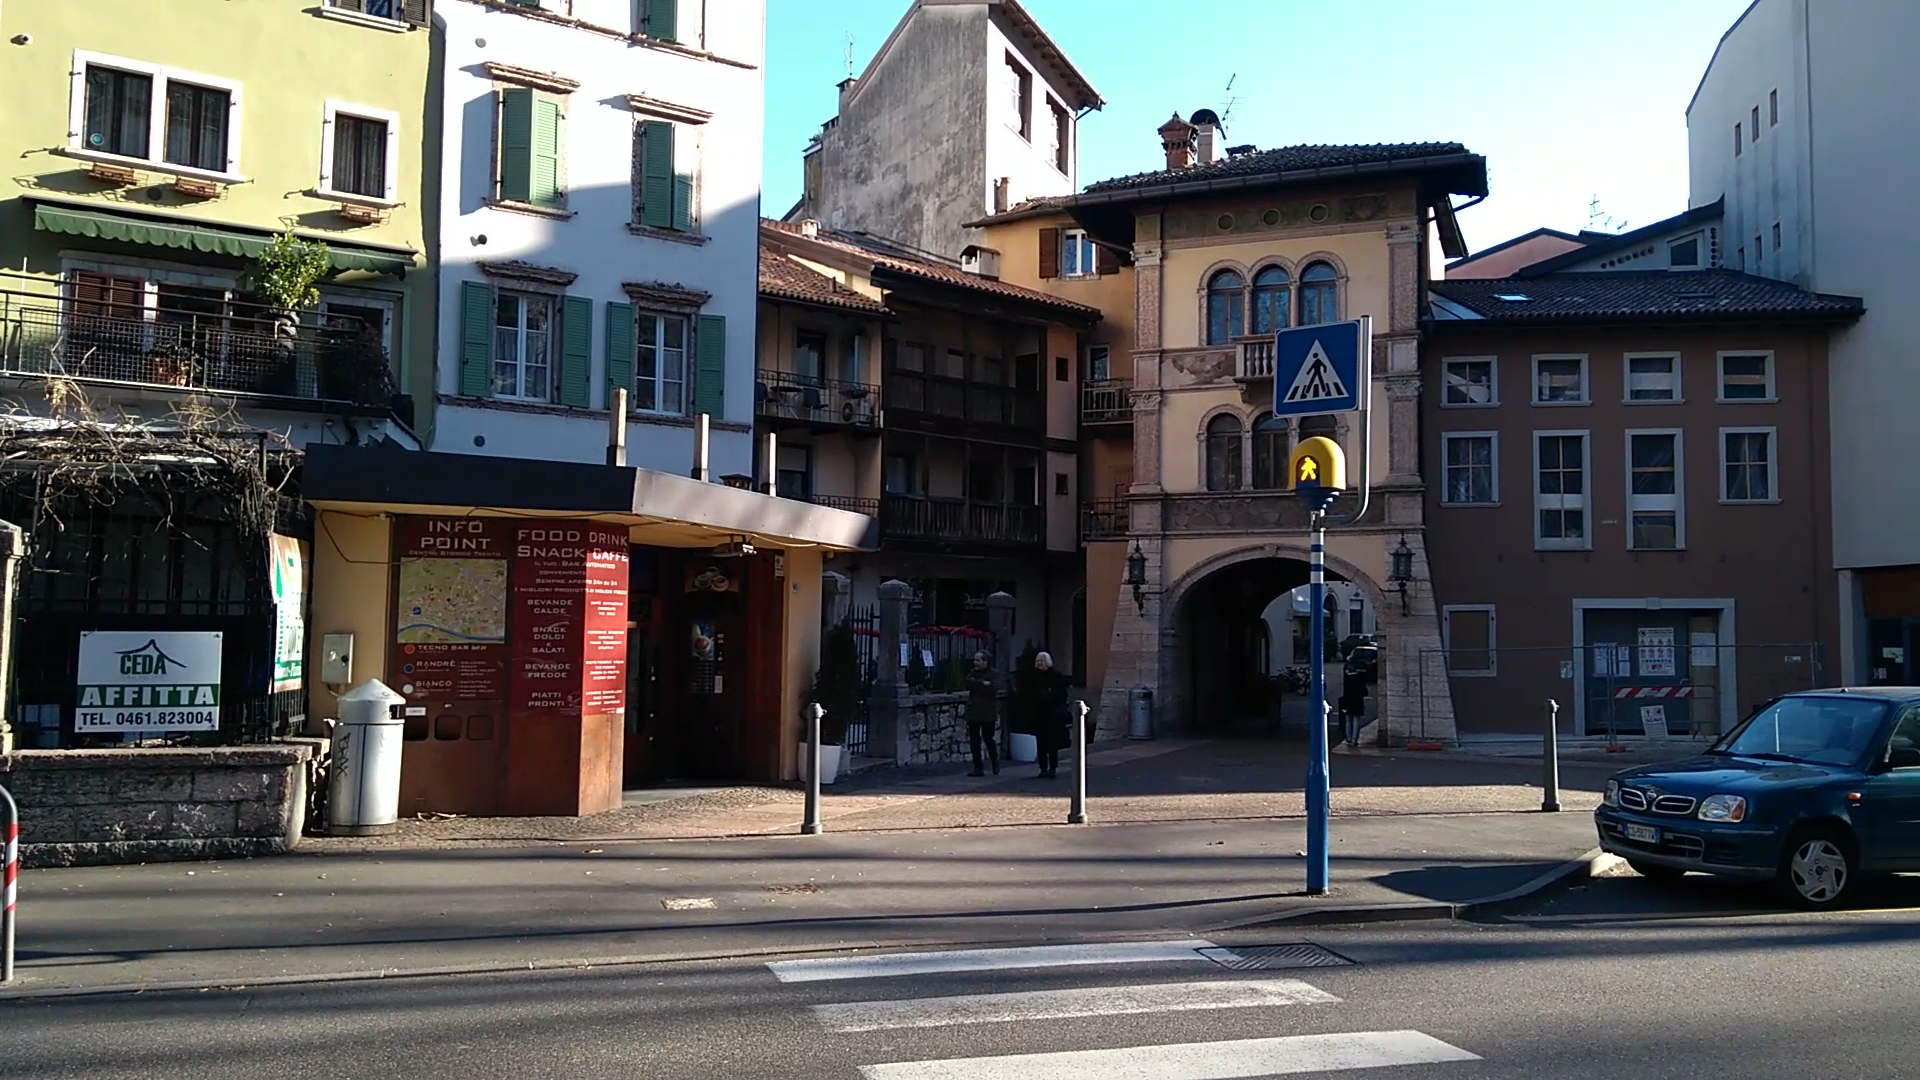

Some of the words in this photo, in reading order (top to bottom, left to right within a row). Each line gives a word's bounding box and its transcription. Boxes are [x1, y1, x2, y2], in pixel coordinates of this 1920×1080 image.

[428, 520, 483, 533] INFO
[421, 537, 491, 549] POINT
[518, 530, 581, 541] FOOD
[589, 532, 628, 546] DRINK
[517, 545, 586, 558] SNACK
[120, 654, 167, 675] CEDA
[81, 686, 215, 706] AFFITTA
[80, 712, 111, 726] TEL.
[116, 711, 213, 725] 0461.823004
